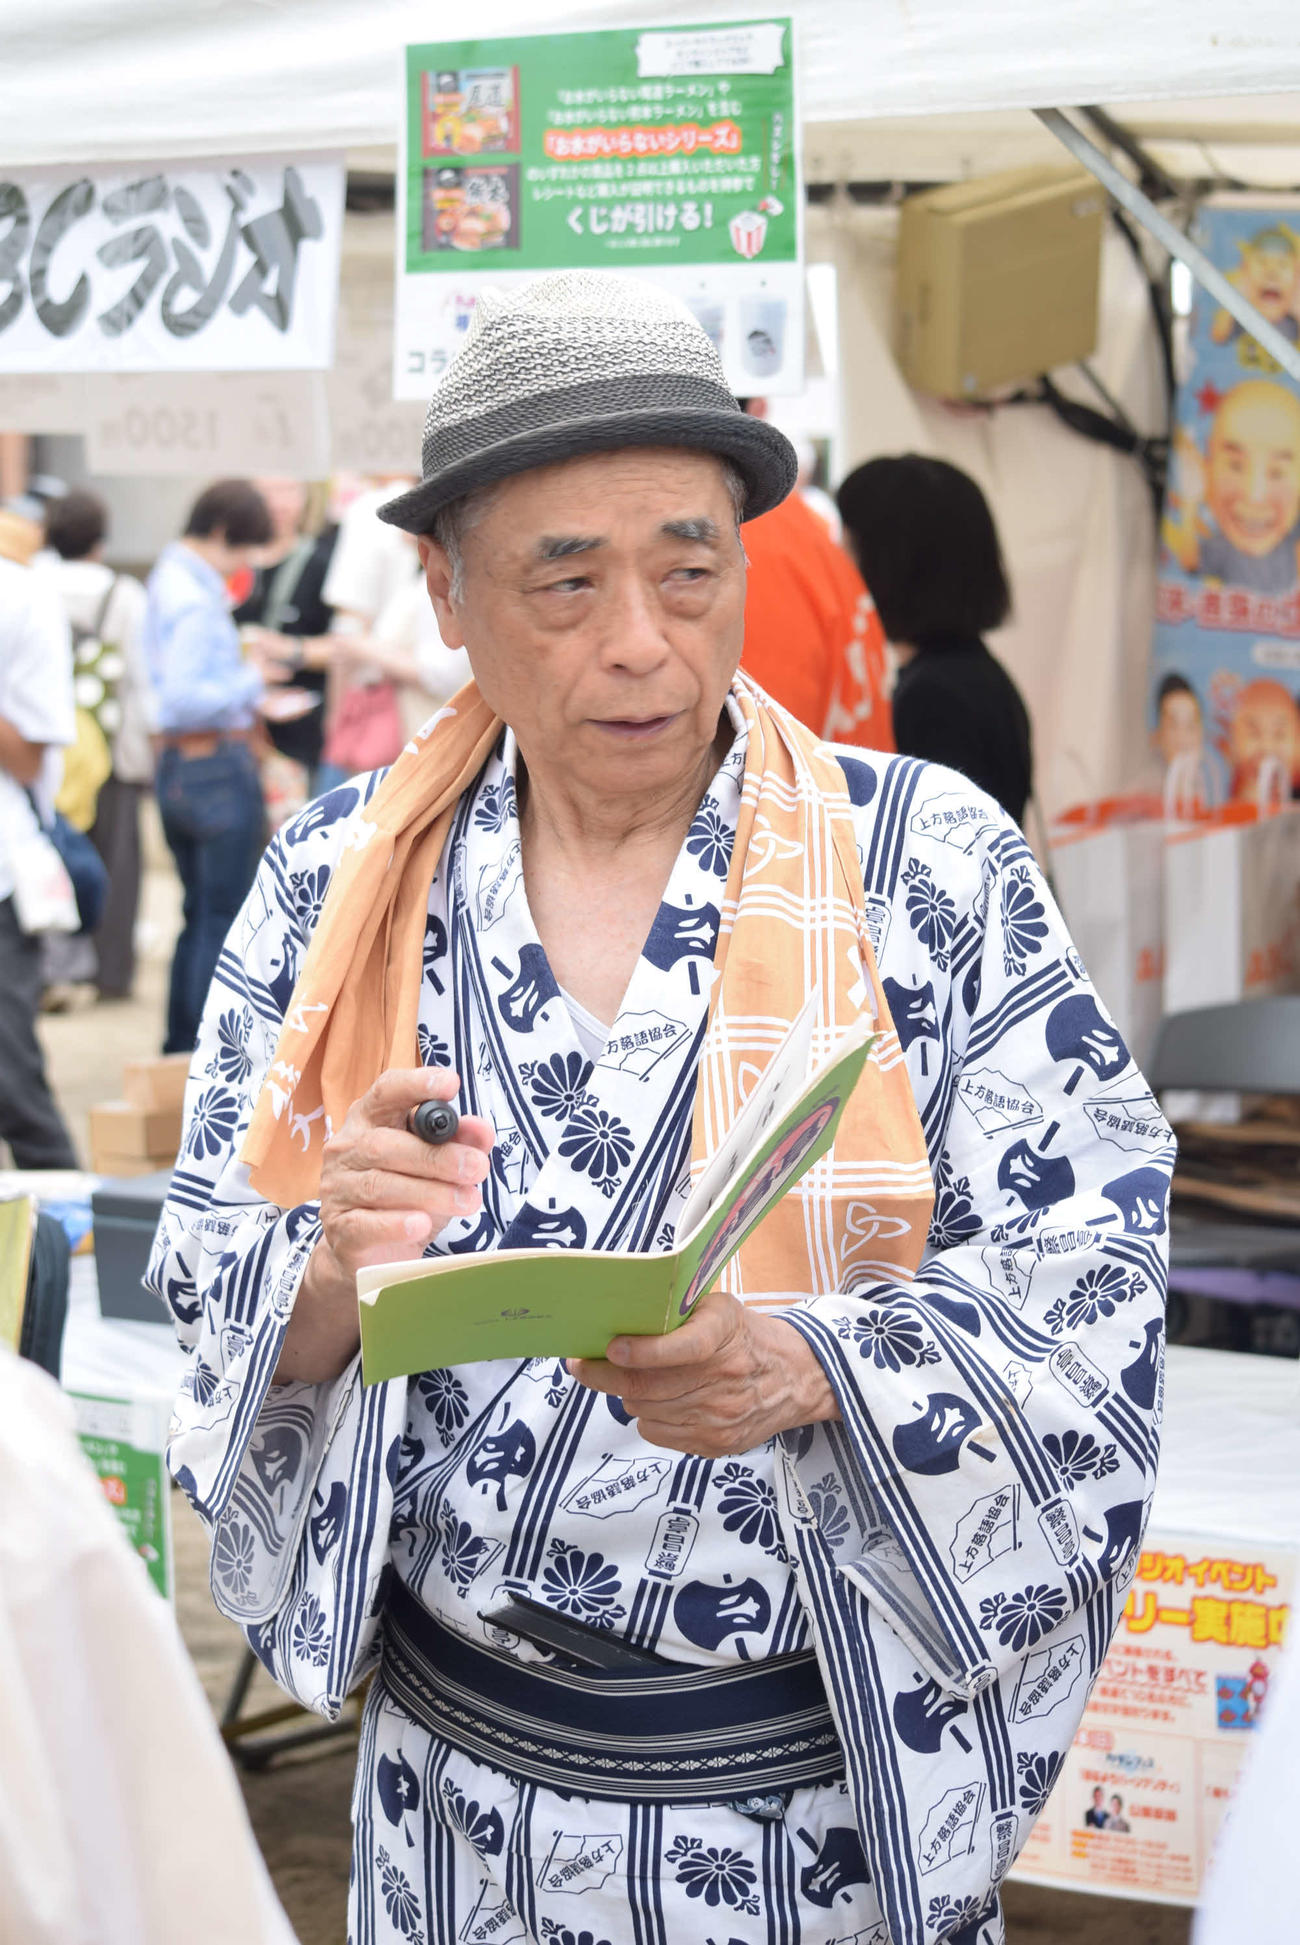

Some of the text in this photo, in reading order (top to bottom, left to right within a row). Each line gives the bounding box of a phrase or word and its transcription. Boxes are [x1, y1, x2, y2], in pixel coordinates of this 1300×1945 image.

[604, 1022, 679, 1056] 方落語協会
[960, 1078, 1036, 1116] 上方落語協会
[575, 1461, 664, 1512] 上方落語協会
[957, 1493, 1011, 1575] 上方落語協会
[1018, 1642, 1081, 1718] 上方落語協会
[922, 1788, 977, 1868] 上方落語協会
[548, 1839, 615, 1889] 上方落語協会
